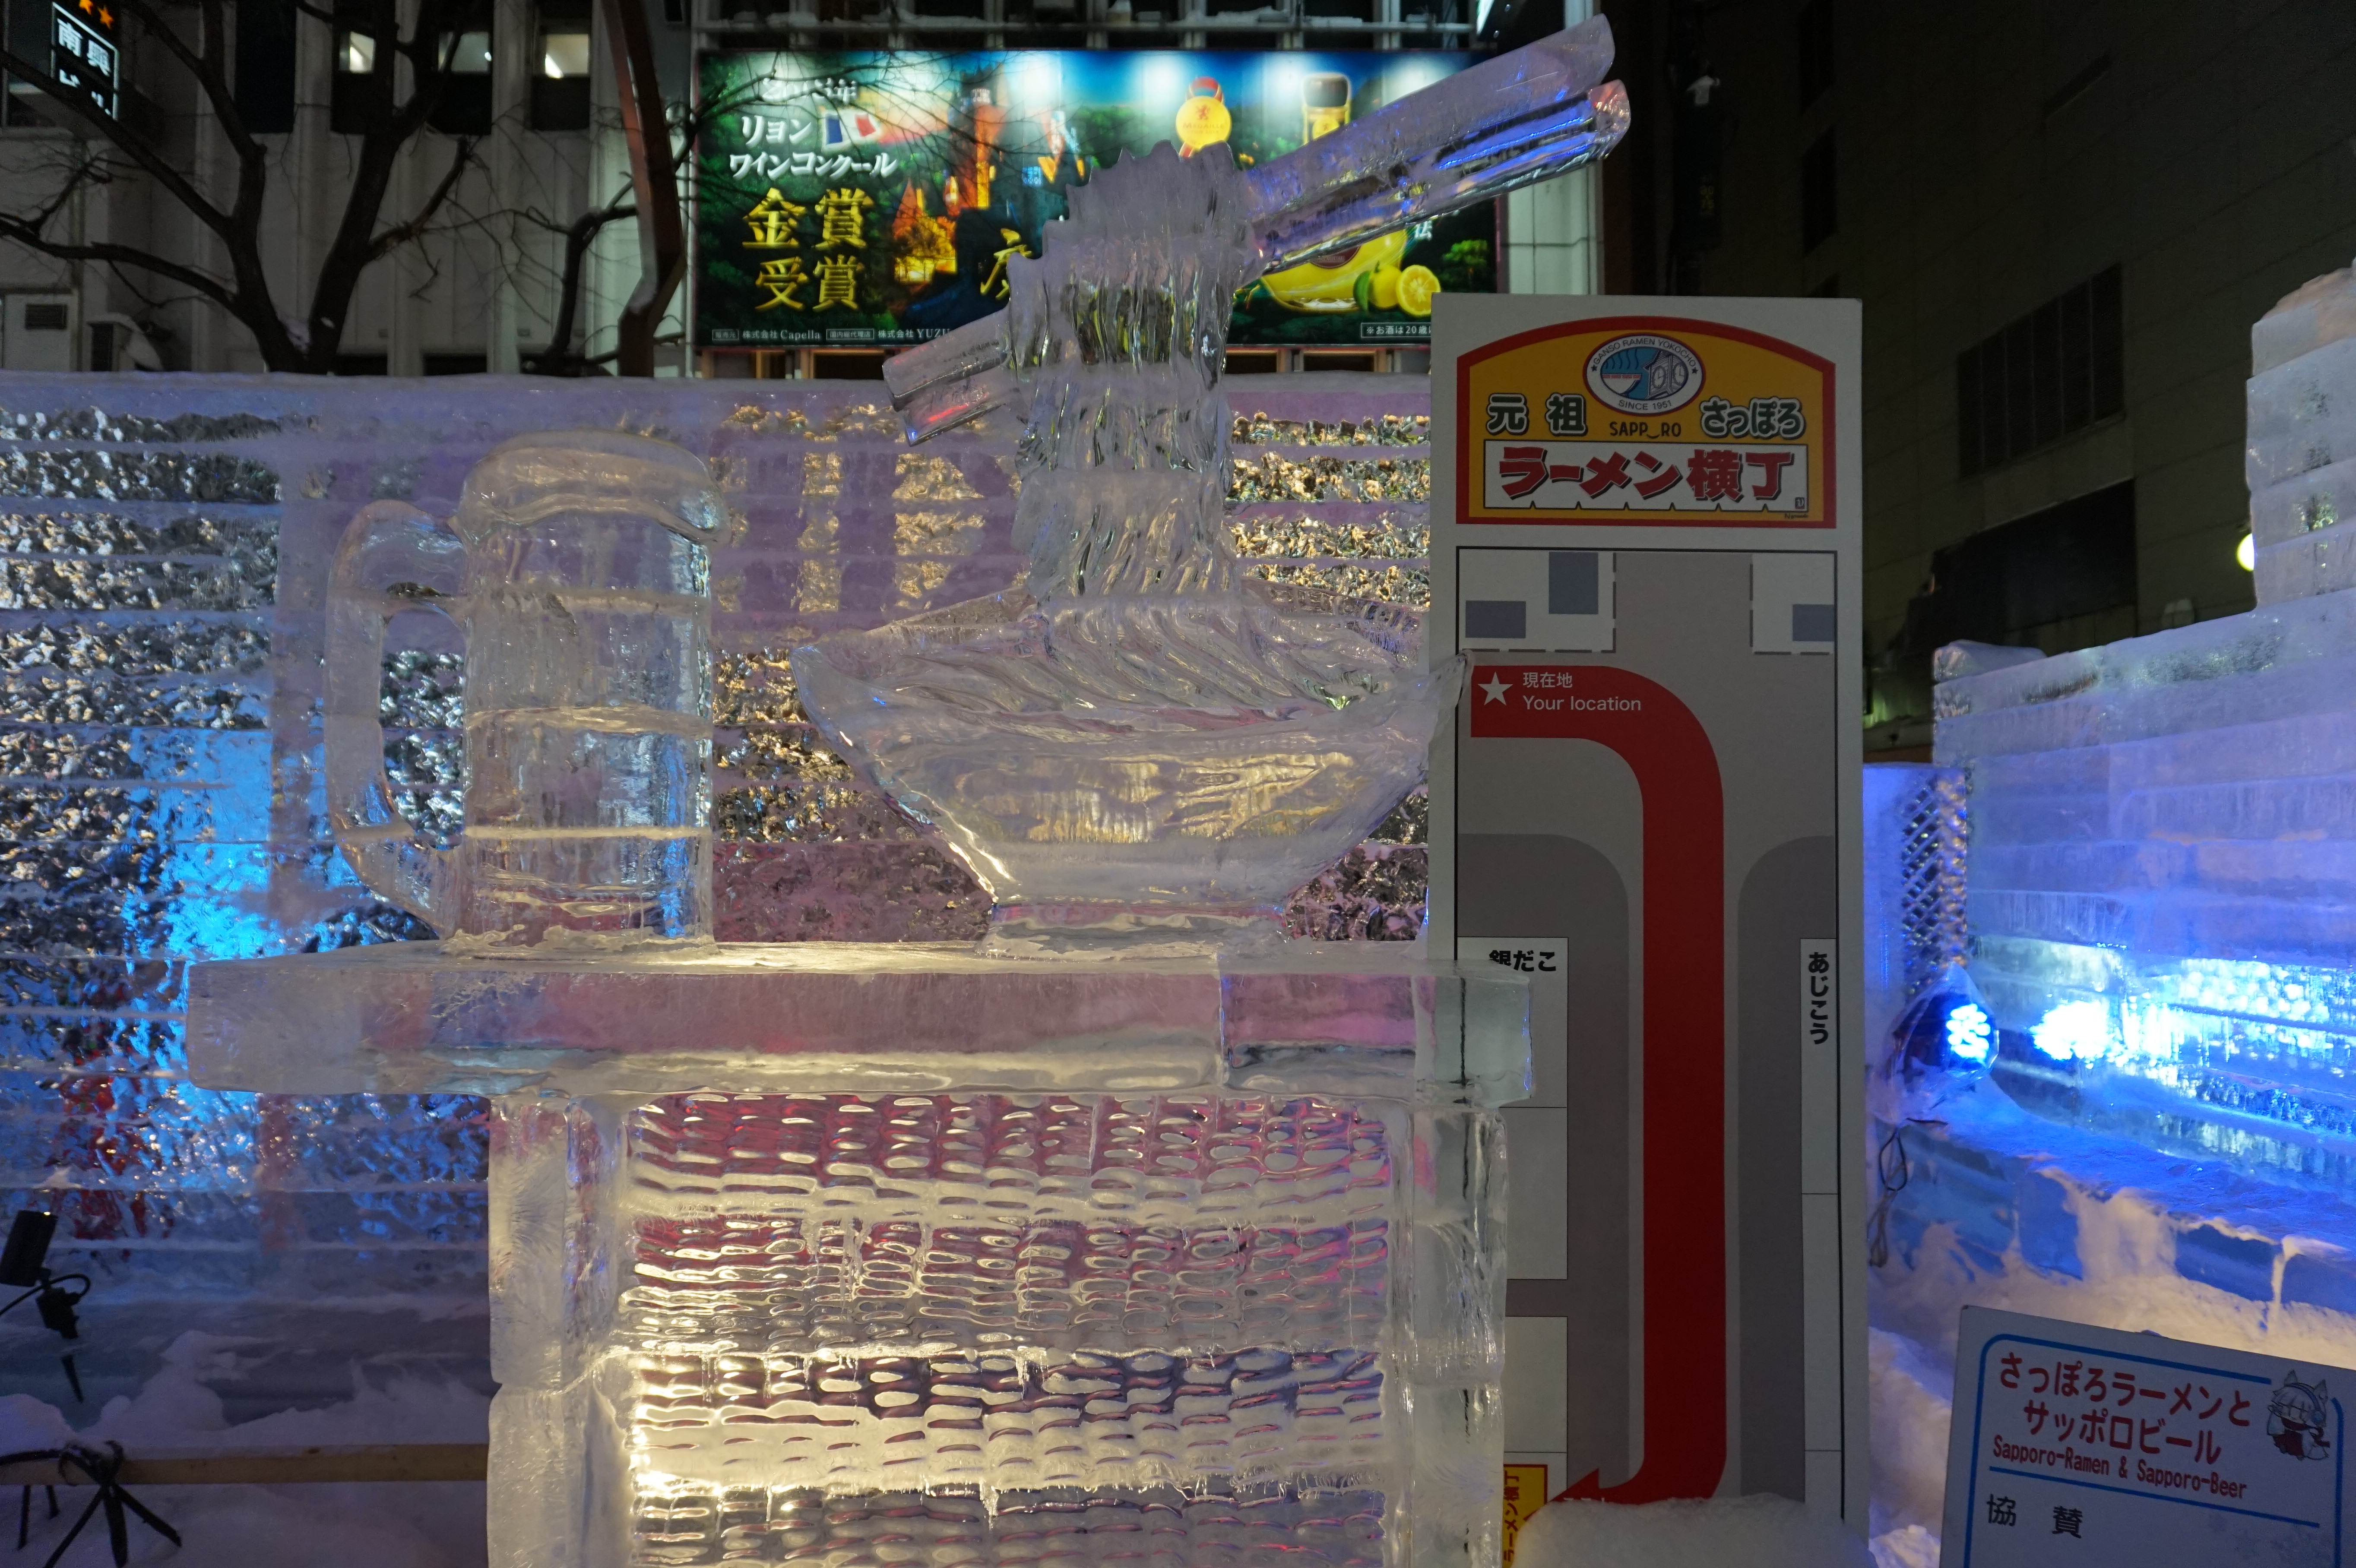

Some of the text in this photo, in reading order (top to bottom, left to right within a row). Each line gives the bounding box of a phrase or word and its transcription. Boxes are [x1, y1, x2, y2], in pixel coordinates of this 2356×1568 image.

[730, 151, 899, 180] ワインコンクール
[742, 187, 874, 250] 金賞
[755, 254, 864, 312] 受賞
[742, 330, 777, 339] 株式会社
[780, 330, 820, 341] Capella
[878, 329, 914, 338] 株式会社
[1593, 338, 1696, 367] GANSO RAMEN YOKOCHO
[1619, 399, 1672, 410] SINCE 1951
[1700, 396, 1805, 439] さっぽろ
[1499, 446, 1794, 503] ラーメン横丁
[1523, 672, 1573, 688] 現在地
[1523, 695, 1641, 711] Your location
[1808, 952, 1829, 1045] あじこう
[2000, 1352, 2250, 1426] さっぽろラーメンと
[2024, 1400, 2221, 1464] サッポロビール
[1993, 1435, 2247, 1499] Sapporo-Ramen & Sapporo-Beer
